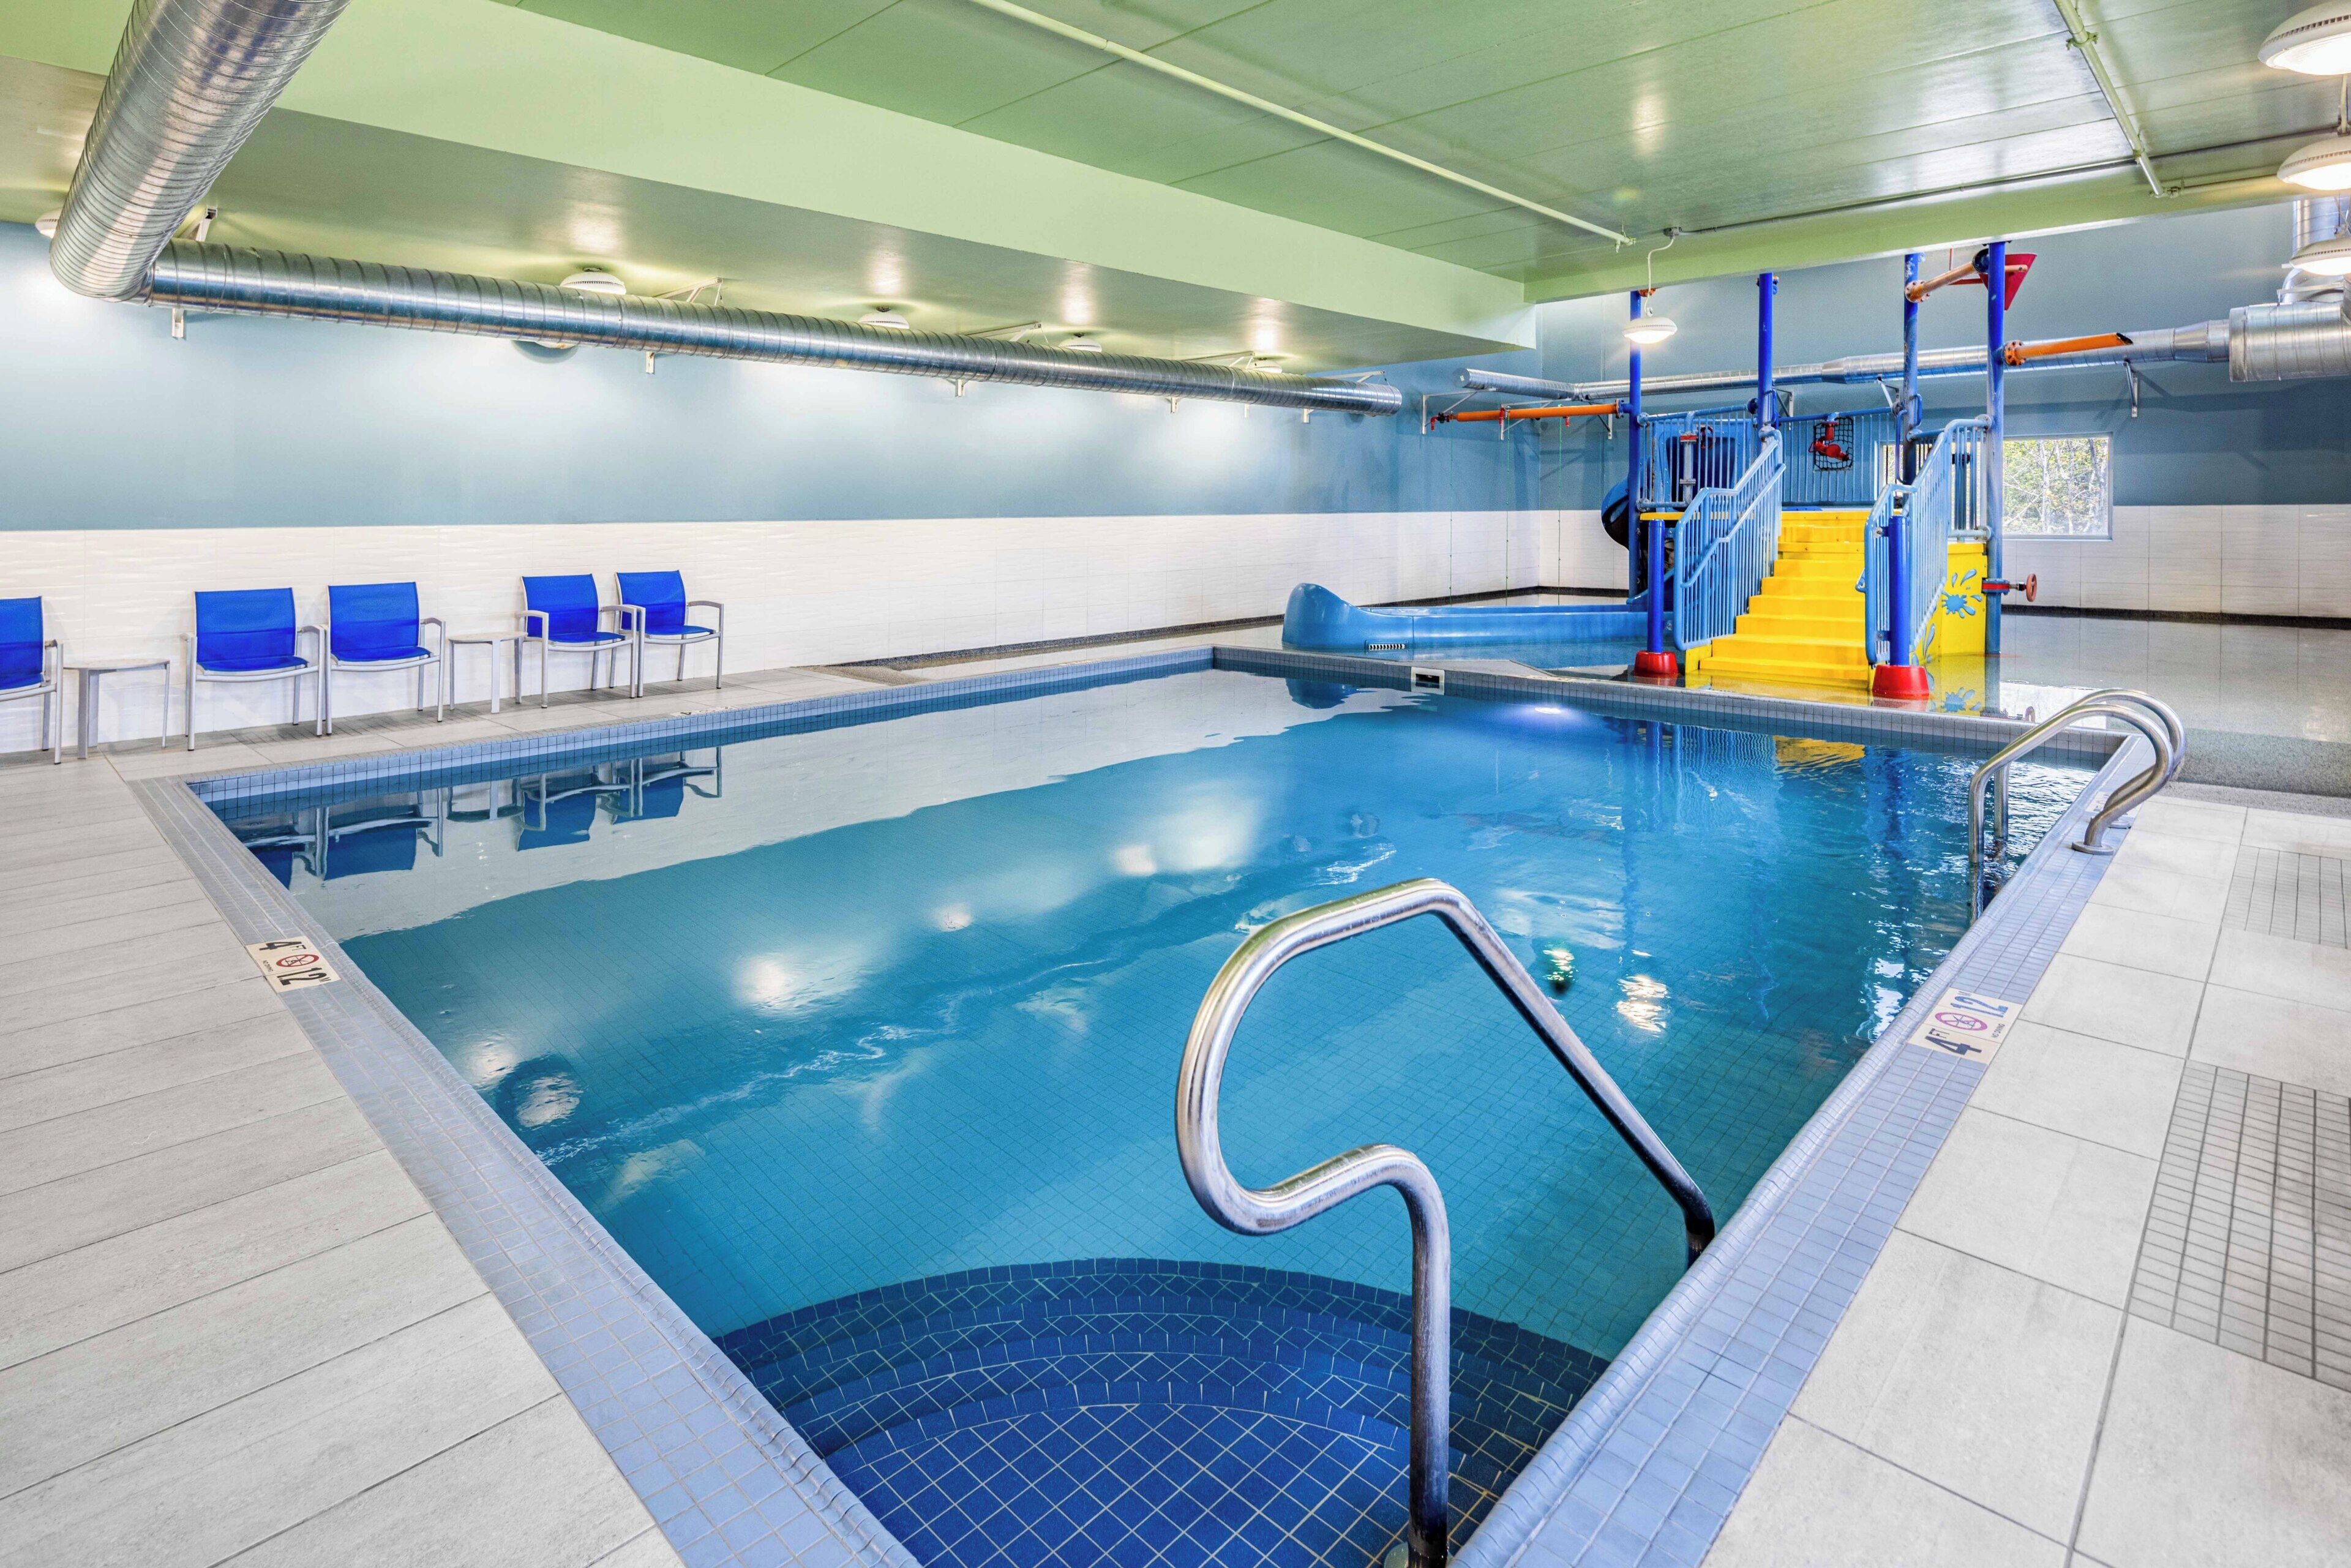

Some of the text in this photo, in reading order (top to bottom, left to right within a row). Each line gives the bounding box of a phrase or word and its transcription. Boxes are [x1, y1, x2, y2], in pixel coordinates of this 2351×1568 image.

[259, 941, 302, 951] 4
[1925, 1028, 1982, 1055] 4 FT
